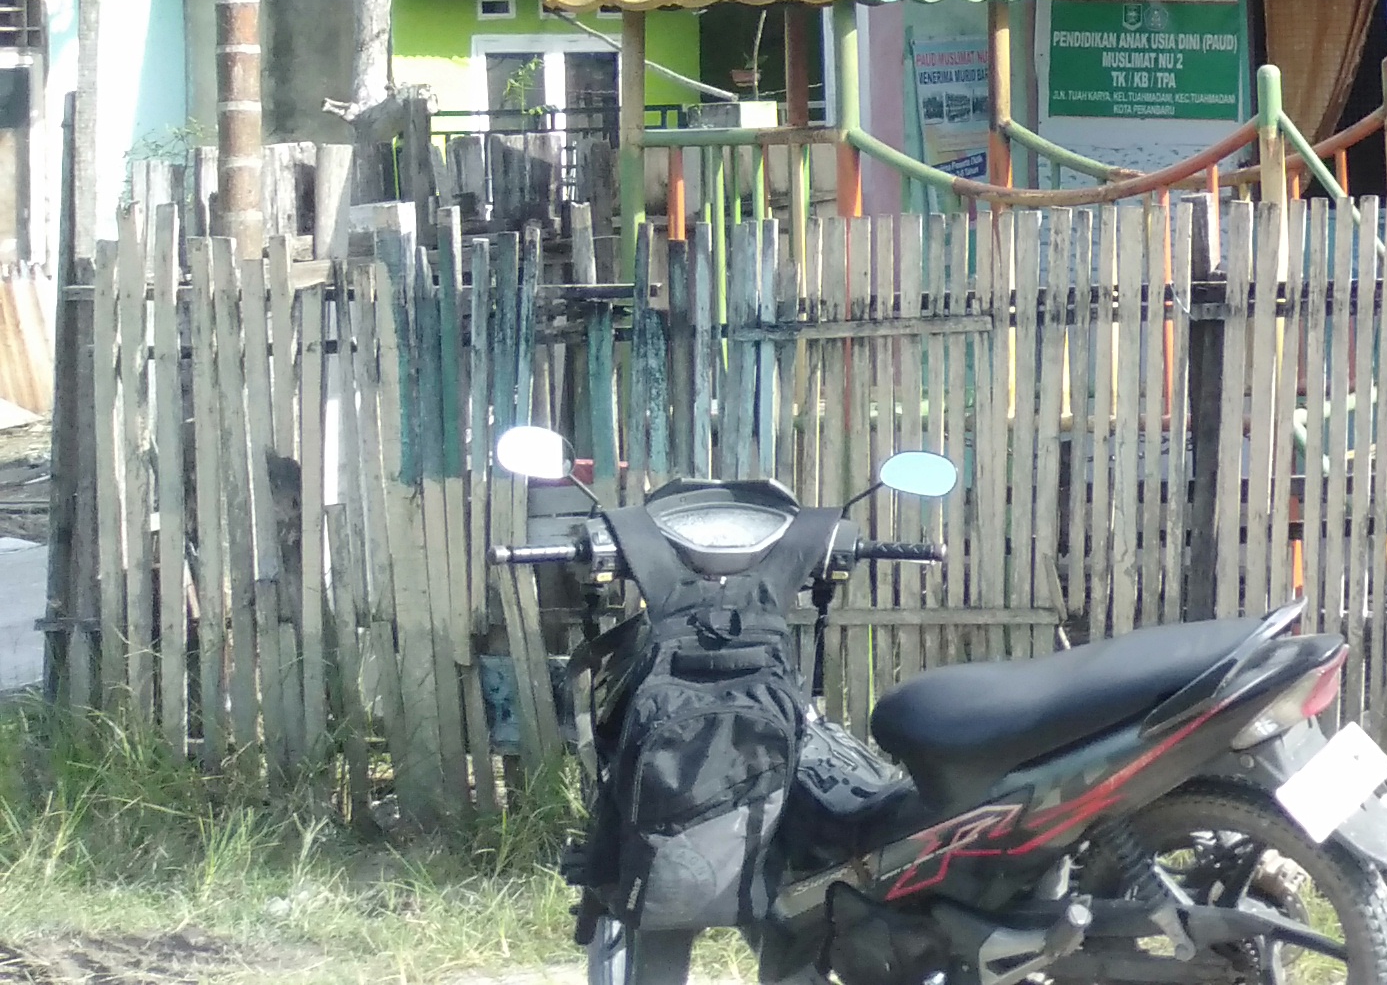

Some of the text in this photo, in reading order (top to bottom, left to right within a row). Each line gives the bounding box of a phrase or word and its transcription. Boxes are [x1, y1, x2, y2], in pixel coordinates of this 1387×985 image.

[1053, 31, 1237, 53] PENDIDIKAN ANAK USIA DINI (PAUD)
[916, 53, 935, 66] PAUD
[938, 50, 974, 65] MUSLIMAT
[1102, 52, 1183, 69] MUSLIMAT NU 2
[919, 70, 954, 85] MENERIMA
[954, 68, 976, 83] MURID
[1111, 72, 1126, 87] TK
[1133, 72, 1148, 87] KB
[1157, 72, 1176, 88] TPA
[1068, 91, 1087, 101] TUAH
[1113, 104, 1175, 115] KOTA PEKANBARU
